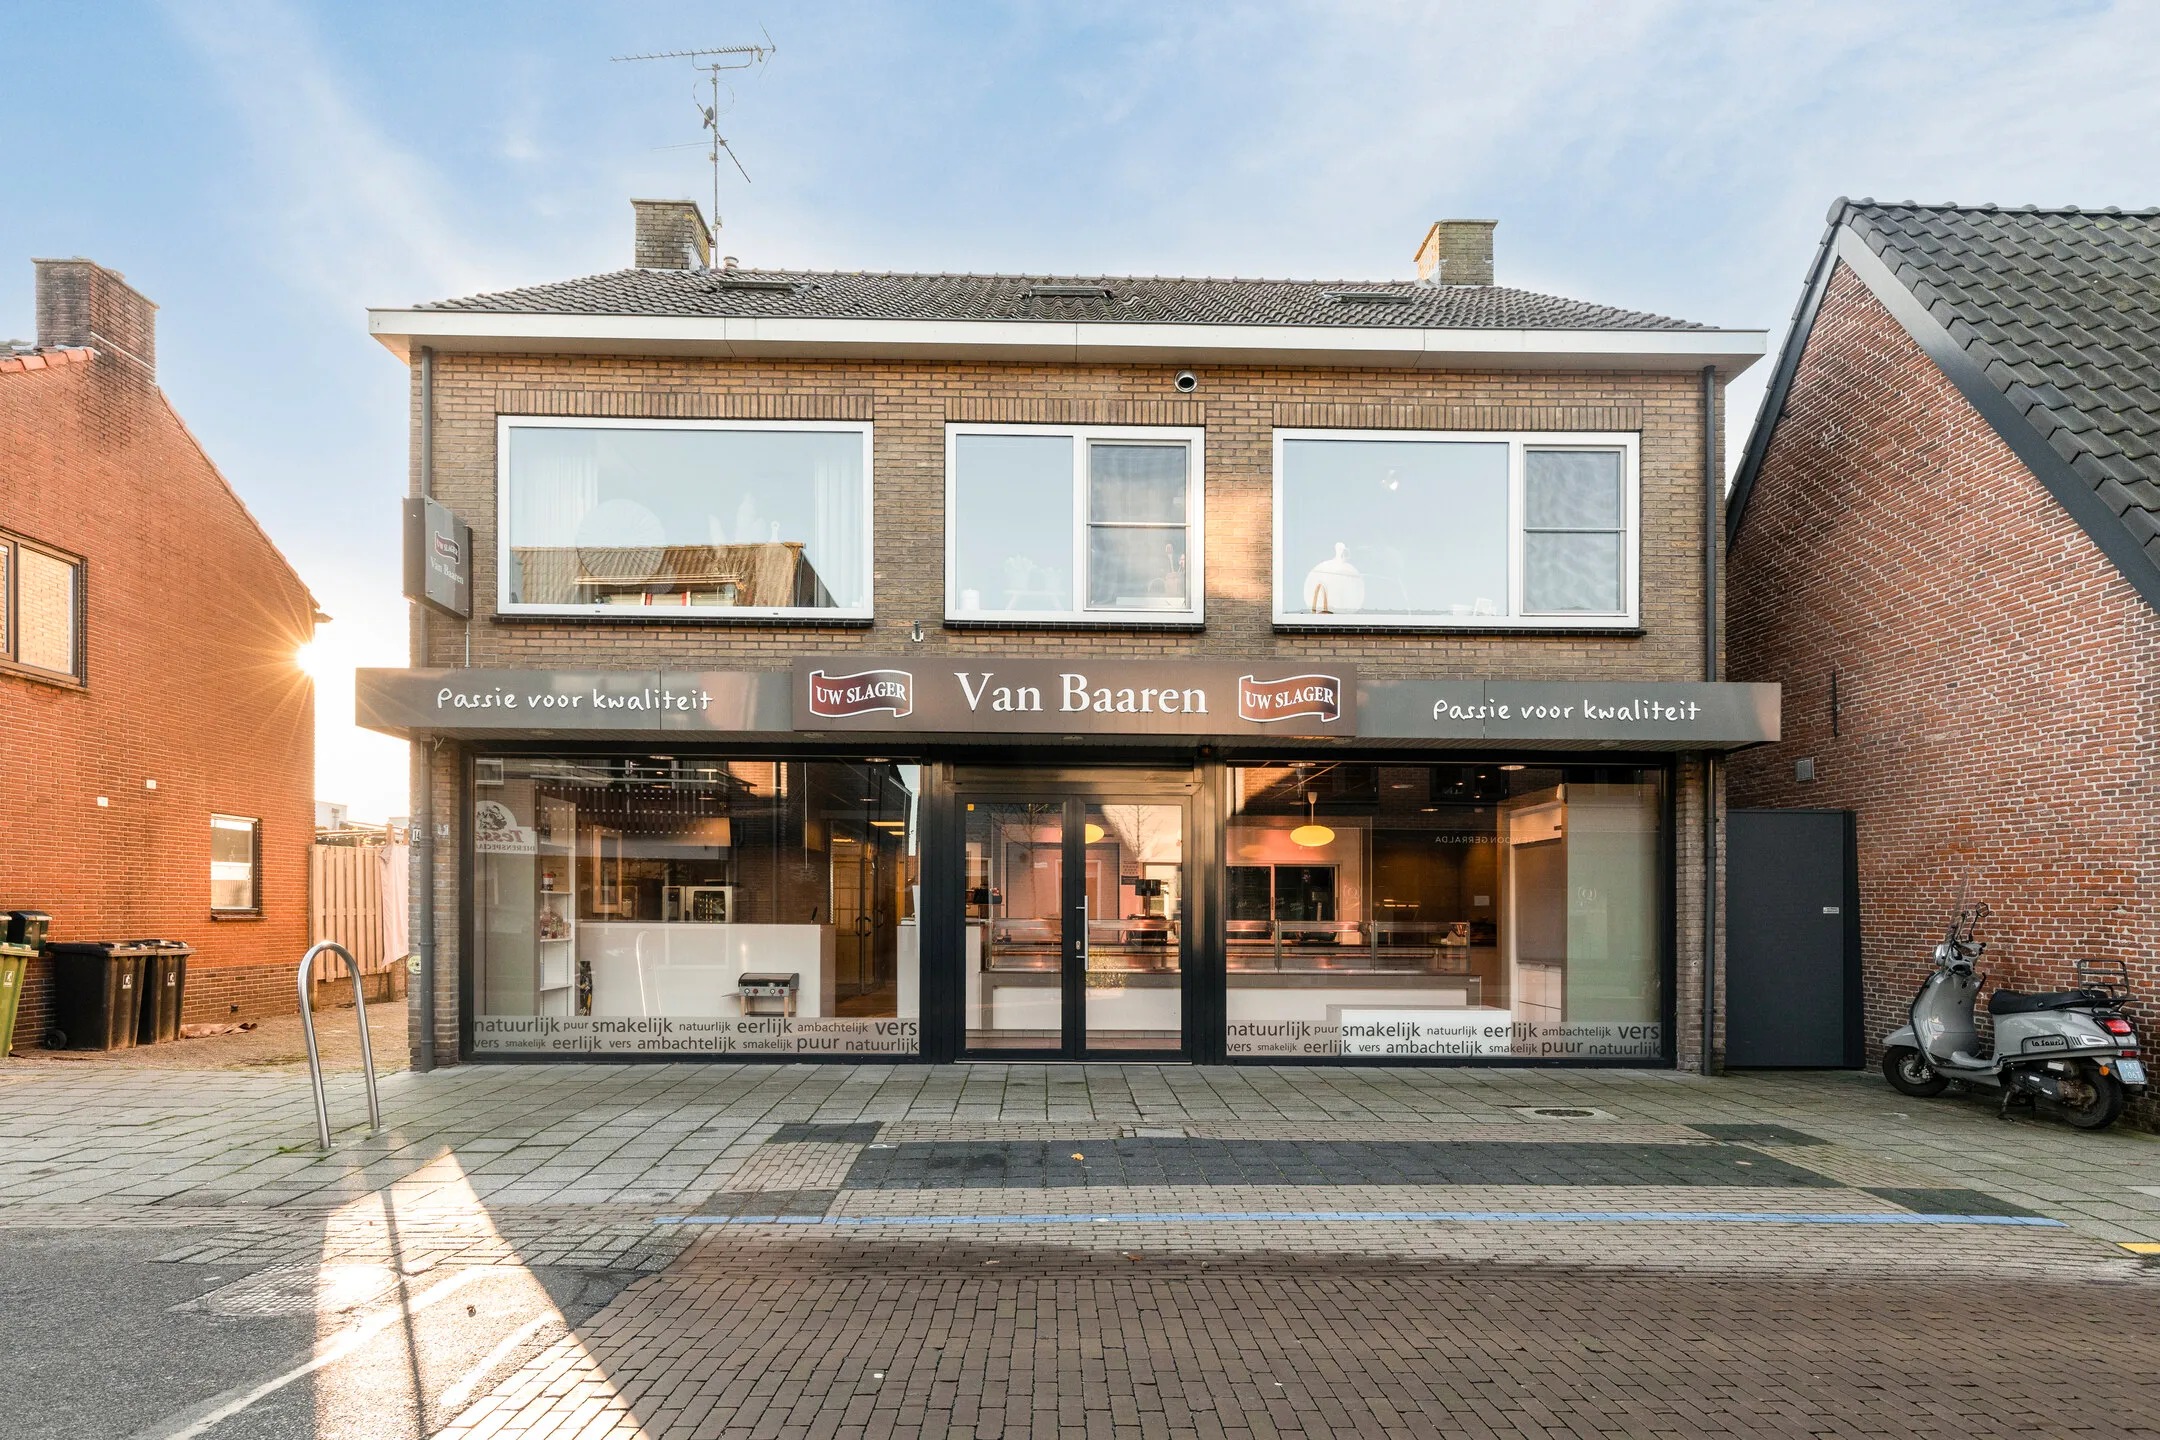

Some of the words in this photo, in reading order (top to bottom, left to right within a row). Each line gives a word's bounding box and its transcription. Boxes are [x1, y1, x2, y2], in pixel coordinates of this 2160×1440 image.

[431, 556, 442, 573] Van
[444, 564, 464, 584] Baaren
[436, 687, 518, 709] Passie
[528, 692, 583, 709] voor
[593, 688, 713, 711] kwaliteit
[816, 685, 843, 705] UW
[846, 681, 907, 704] SLAGER
[953, 672, 1044, 712] Van
[1058, 673, 1209, 713] Baaren
[1245, 690, 1272, 709] UW
[1275, 686, 1335, 708] SLAGER
[1433, 698, 1511, 720] Passie
[1520, 703, 1574, 719] voor
[1584, 699, 1701, 721] kwaliteit
[474, 1017, 559, 1036] natuurlijk
[563, 1021, 588, 1031] puur
[592, 1017, 673, 1036] smakelijk
[679, 1021, 731, 1033] natuurlijk
[737, 1018, 793, 1037] eerlijk
[797, 1022, 868, 1033] ambachtelijk
[875, 1021, 917, 1036] vers
[1227, 1021, 1311, 1040] natuurlijk
[1314, 1025, 1338, 1035] puur
[1342, 1022, 1421, 1040] smakelijk
[1427, 1025, 1477, 1037] natuurlijk
[1483, 1023, 1538, 1041] eerlijk
[1542, 1026, 1611, 1037] ambachtelijk
[1618, 1025, 1660, 1040] vers
[474, 1038, 500, 1048] vers
[505, 1039, 546, 1049] smakelijk
[552, 1036, 602, 1052] eerlijk
[609, 1040, 632, 1049] vers
[637, 1036, 736, 1053] ambachtelijk
[742, 1039, 793, 1051] smakelijk
[797, 1037, 839, 1052] puur
[845, 1038, 919, 1054] natuurlijk
[1227, 1041, 1251, 1052] vers
[1257, 1043, 1297, 1052] smakelijk
[1303, 1040, 1352, 1056] eerlijk
[1359, 1044, 1380, 1052] vers
[1386, 1041, 1483, 1057] ambachtelijk
[1489, 1044, 1538, 1054] smakelijk
[1542, 1041, 1584, 1056] puur
[1589, 1042, 1661, 1058] natuurlijk
